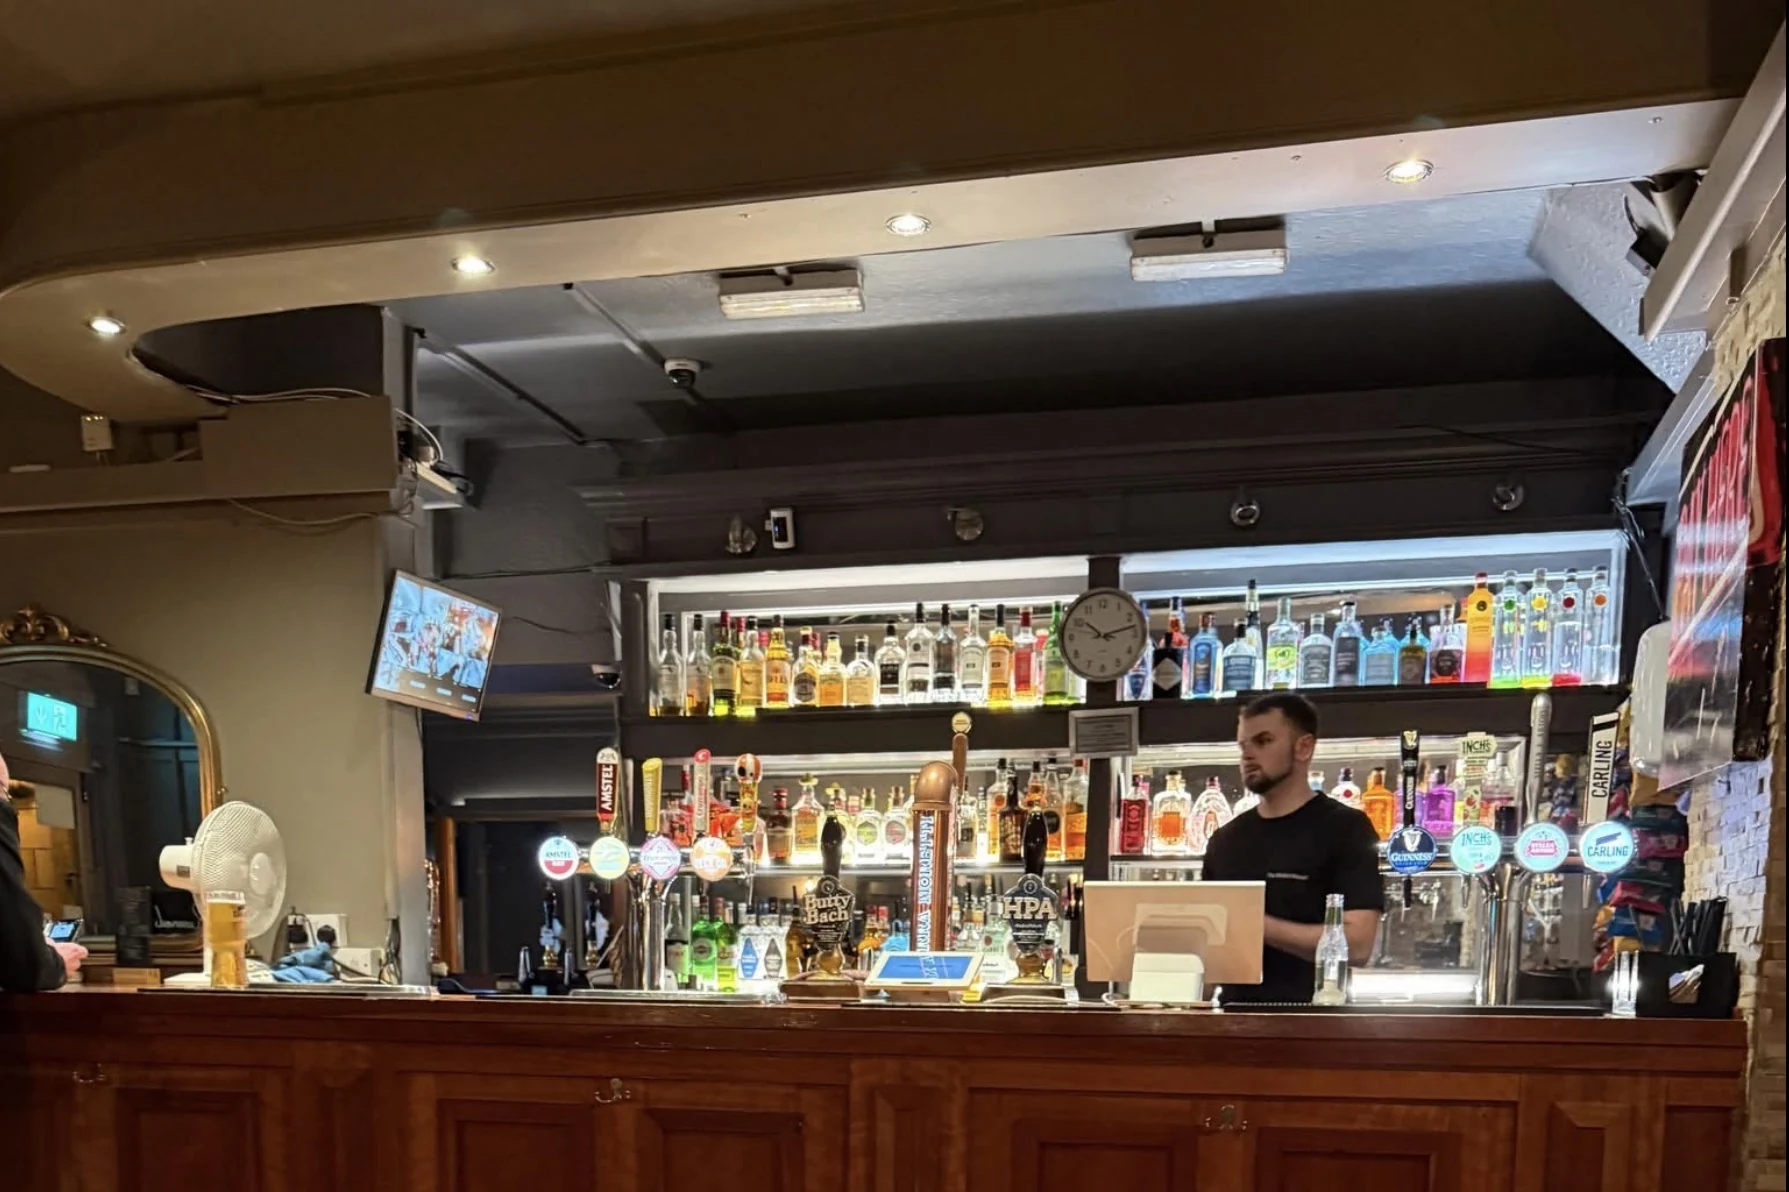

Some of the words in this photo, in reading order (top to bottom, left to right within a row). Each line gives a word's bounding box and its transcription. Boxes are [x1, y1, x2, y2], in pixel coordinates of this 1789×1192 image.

[1591, 740, 1612, 798] CARLING
[600, 764, 615, 811] AMSTEL
[545, 851, 572, 859] AMSTEL
[918, 815, 934, 904] MORETTI
[1390, 852, 1433, 862] GUINNESS
[1587, 846, 1629, 857] CARLING
[804, 893, 852, 910] Butty
[1002, 896, 1058, 919] HPA
[804, 906, 850, 924] Bach
